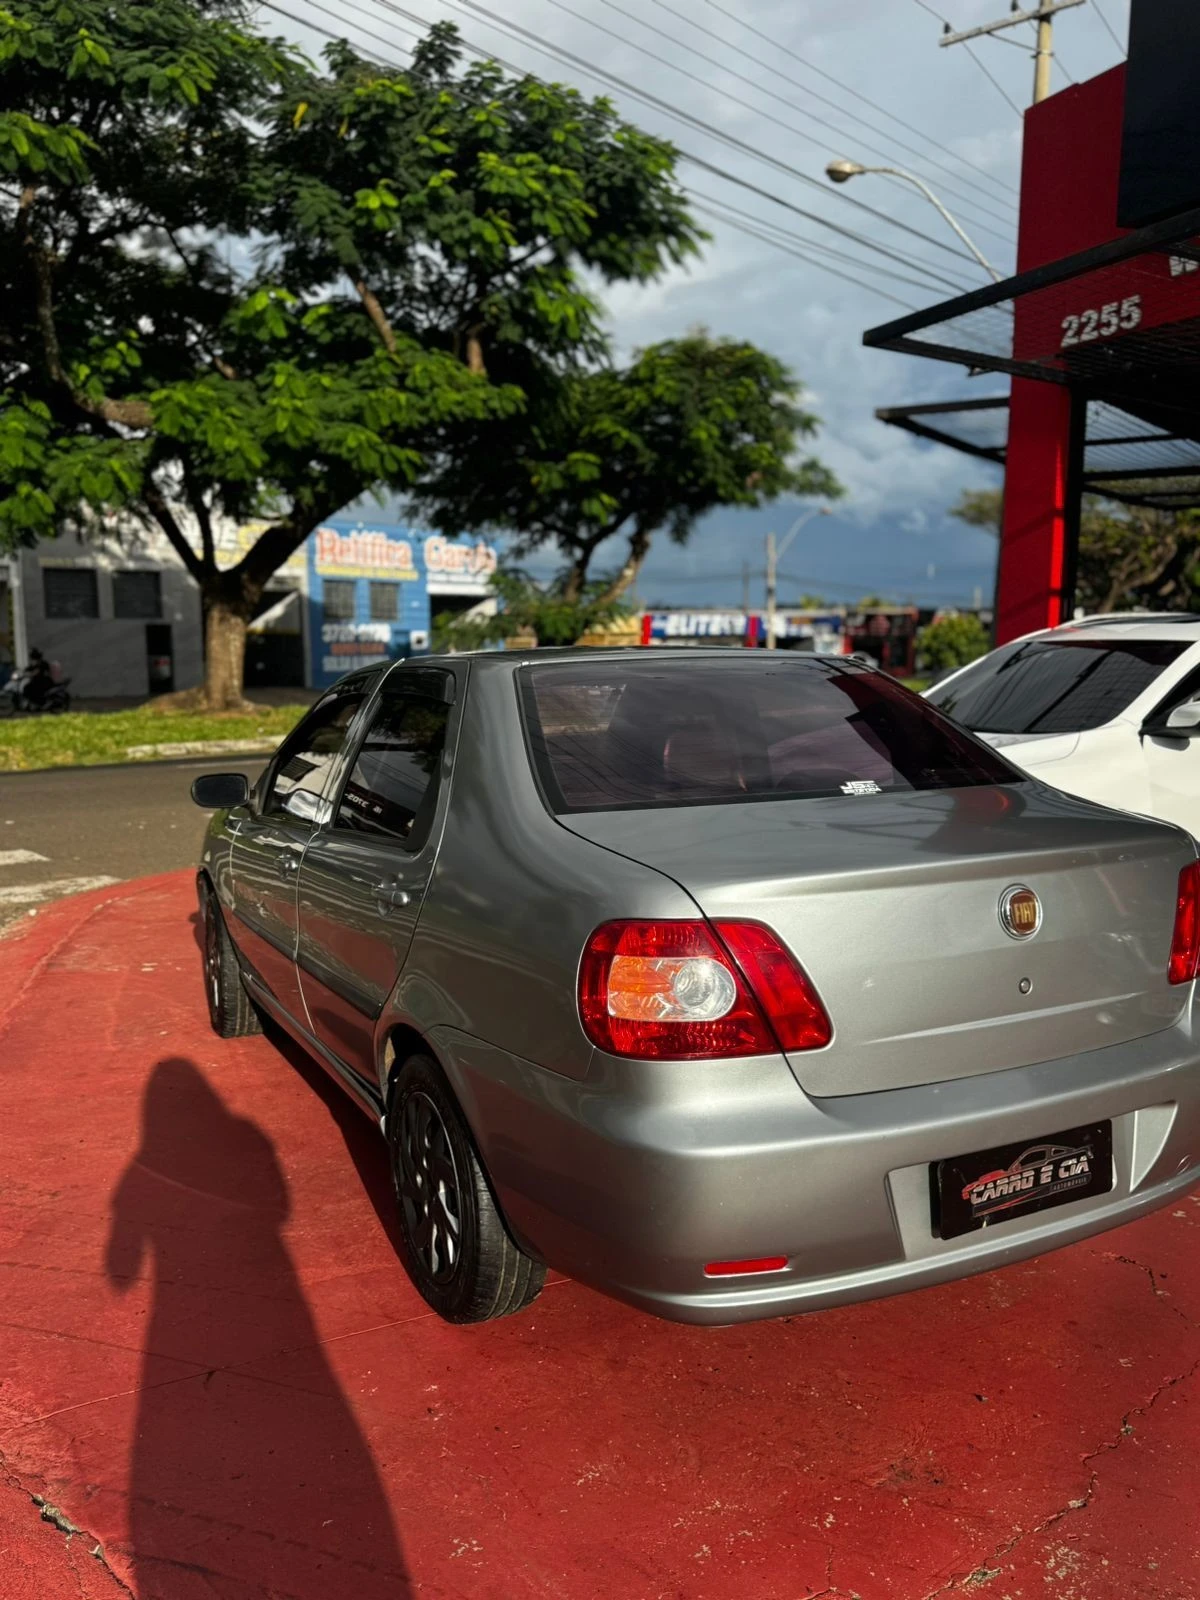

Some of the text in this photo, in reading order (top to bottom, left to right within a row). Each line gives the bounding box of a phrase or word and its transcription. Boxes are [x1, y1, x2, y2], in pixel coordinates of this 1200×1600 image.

[1060, 294, 1142, 348] 2255
[1014, 901, 1035, 924] FIAT
[970, 1155, 1090, 1205] CARRO E CIA
